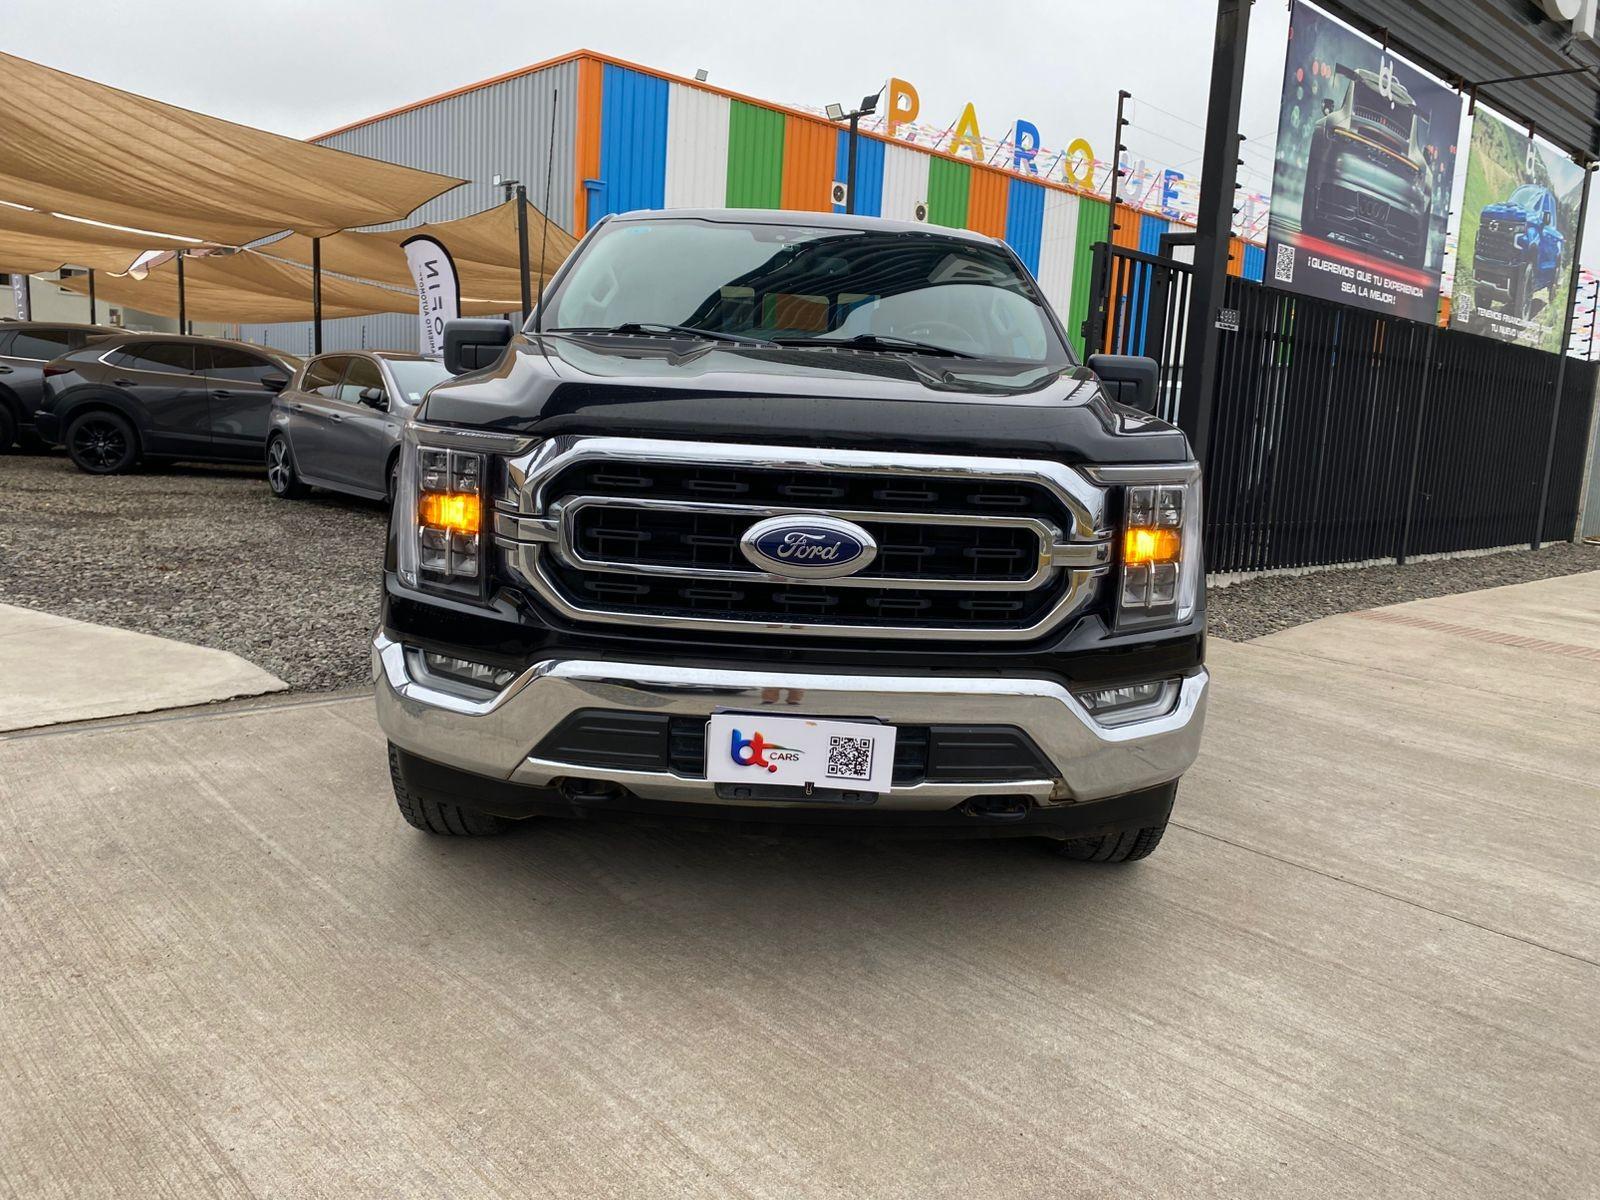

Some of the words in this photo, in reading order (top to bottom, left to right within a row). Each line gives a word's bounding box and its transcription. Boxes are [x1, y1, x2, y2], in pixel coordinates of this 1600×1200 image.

[886, 77, 1185, 221] PARQUE
[1341, 281, 1357, 295] SEA
[1358, 286, 1368, 298] LA
[1369, 289, 1396, 305] MEJOR!
[1356, 270, 1372, 283] QUE
[1373, 275, 1383, 286] TU
[1383, 278, 1424, 298] EXPERIENCIA
[777, 532, 841, 560] Ford
[769, 752, 800, 762] CARS
